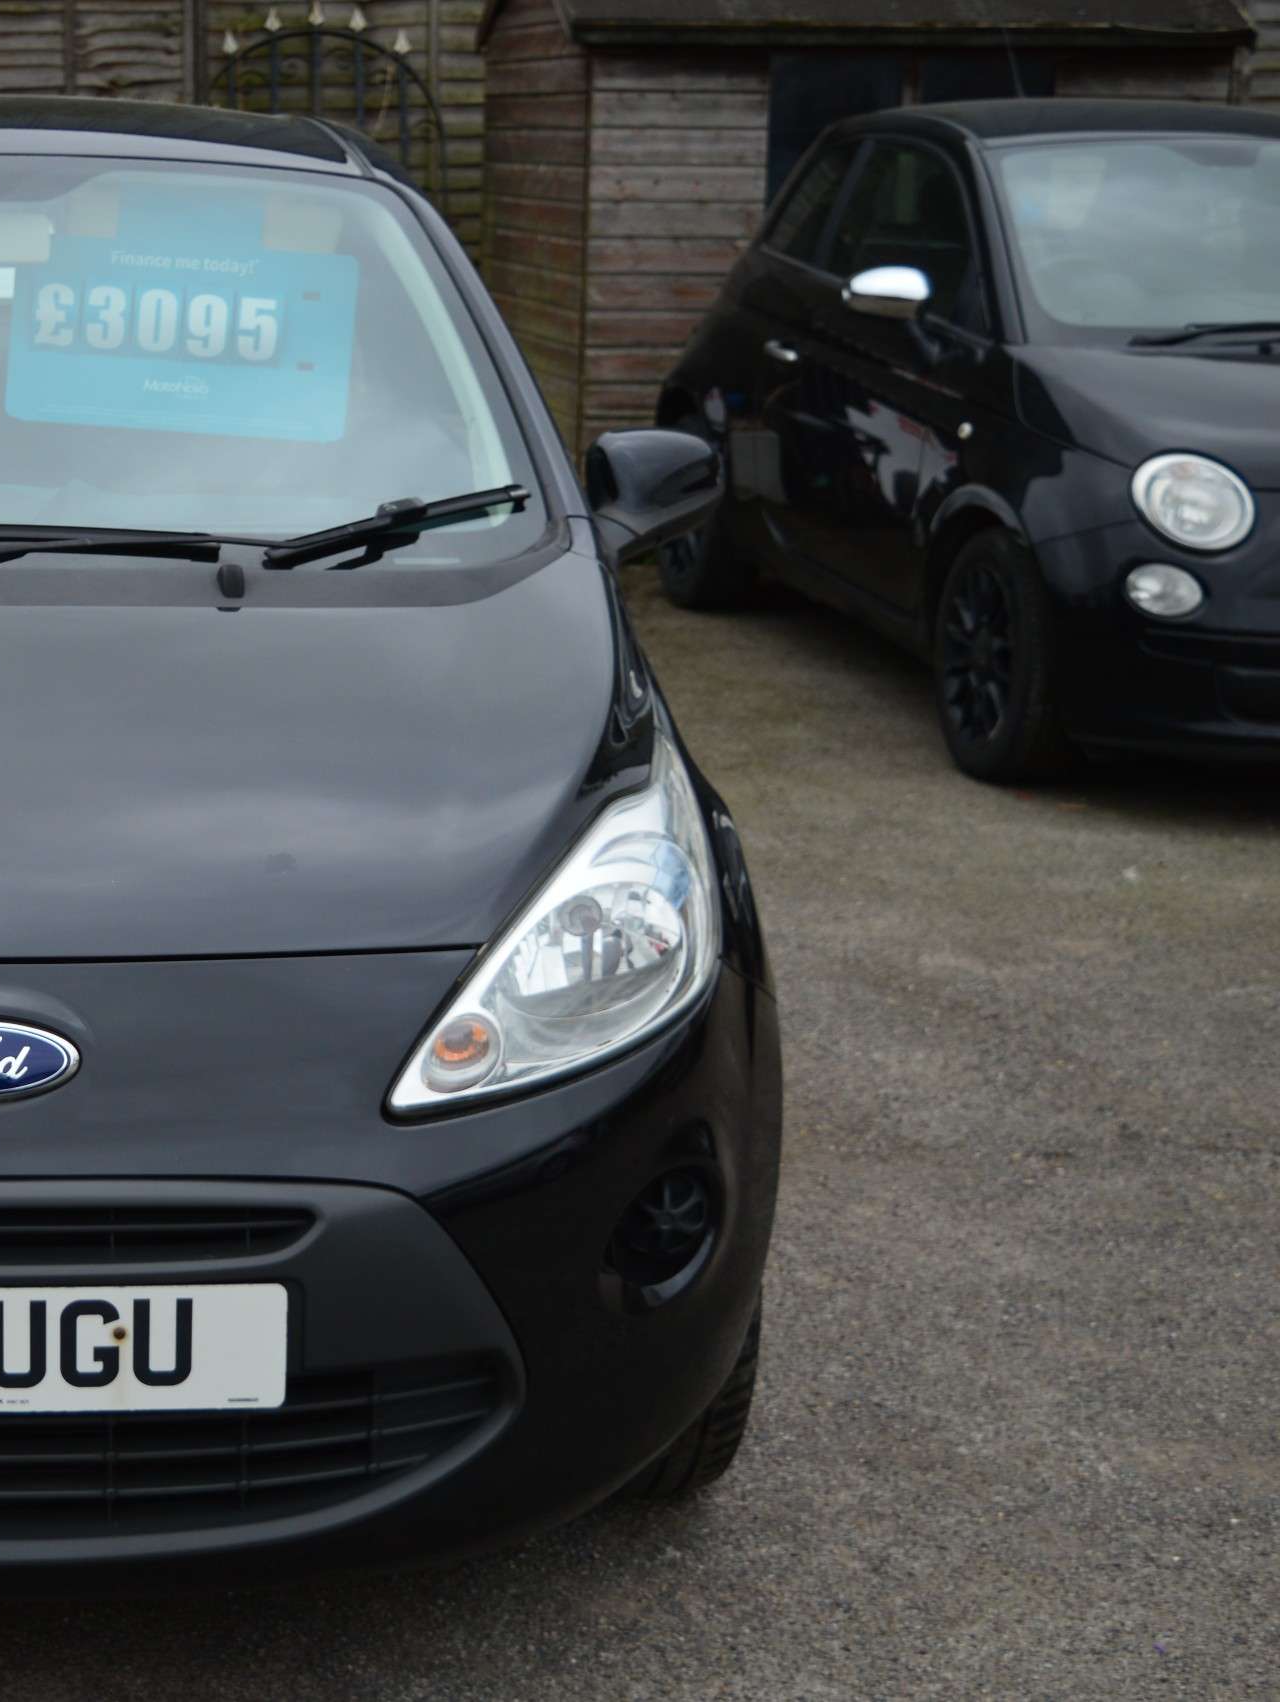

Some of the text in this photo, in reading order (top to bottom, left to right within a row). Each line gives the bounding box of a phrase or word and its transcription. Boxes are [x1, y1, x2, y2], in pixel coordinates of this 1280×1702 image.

[111, 250, 170, 269] Finance
[175, 257, 201, 270] me
[33, 283, 279, 362] £3095
